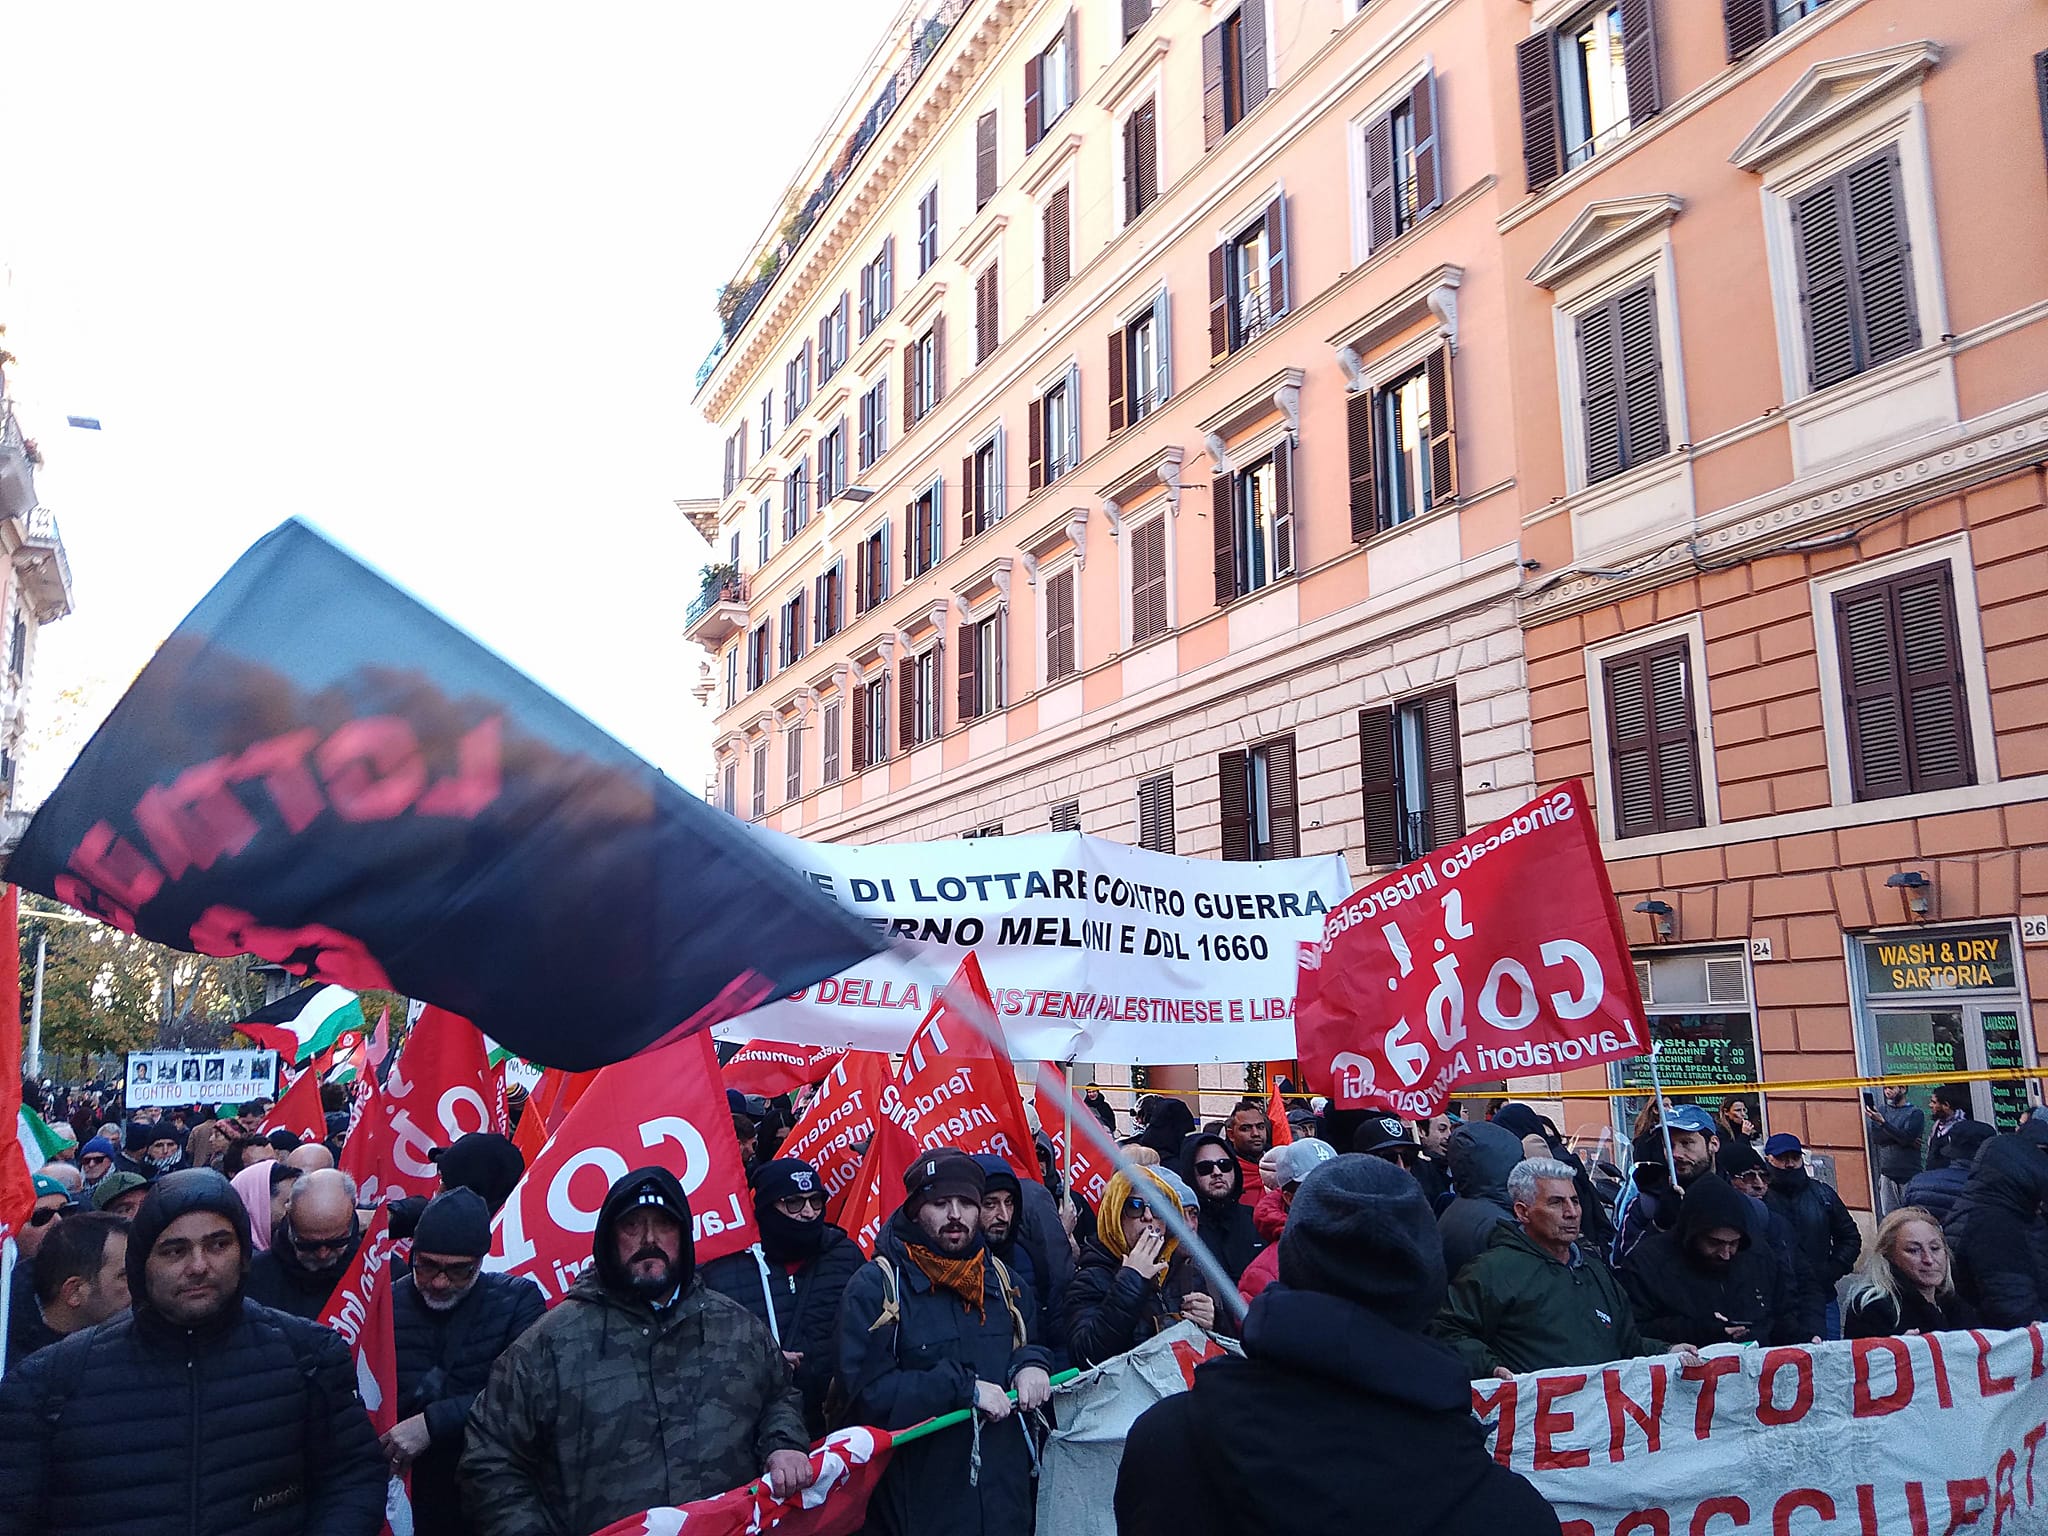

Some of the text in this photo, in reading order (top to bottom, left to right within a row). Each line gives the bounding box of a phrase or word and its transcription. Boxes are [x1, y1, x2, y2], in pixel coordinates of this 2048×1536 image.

[850, 878, 897, 903] DI
[909, 868, 1088, 903] LOTTARE
[1093, 873, 1186, 918] CONTRO
[1194, 890, 1341, 920] GUERRA
[998, 916, 1112, 953] MELONI
[1120, 925, 1136, 954] E
[1143, 927, 1191, 961] DDL
[1197, 933, 1269, 962] 1660
[2024, 921, 2047, 937] 26
[1752, 941, 1771, 956] 24
[1878, 938, 2000, 967] WASH & DRY
[1892, 964, 1994, 990] SARTORIA
[814, 976, 922, 1011] DELLA
[1095, 994, 1224, 1024] PALESTINESE
[1229, 997, 1247, 1023] E
[1698, 1038, 1732, 1048] DRY
[1885, 1042, 1955, 1057] LAVASECCO
[134, 1085, 183, 1101] CONTRO
[1851, 1332, 1954, 1419] DI
